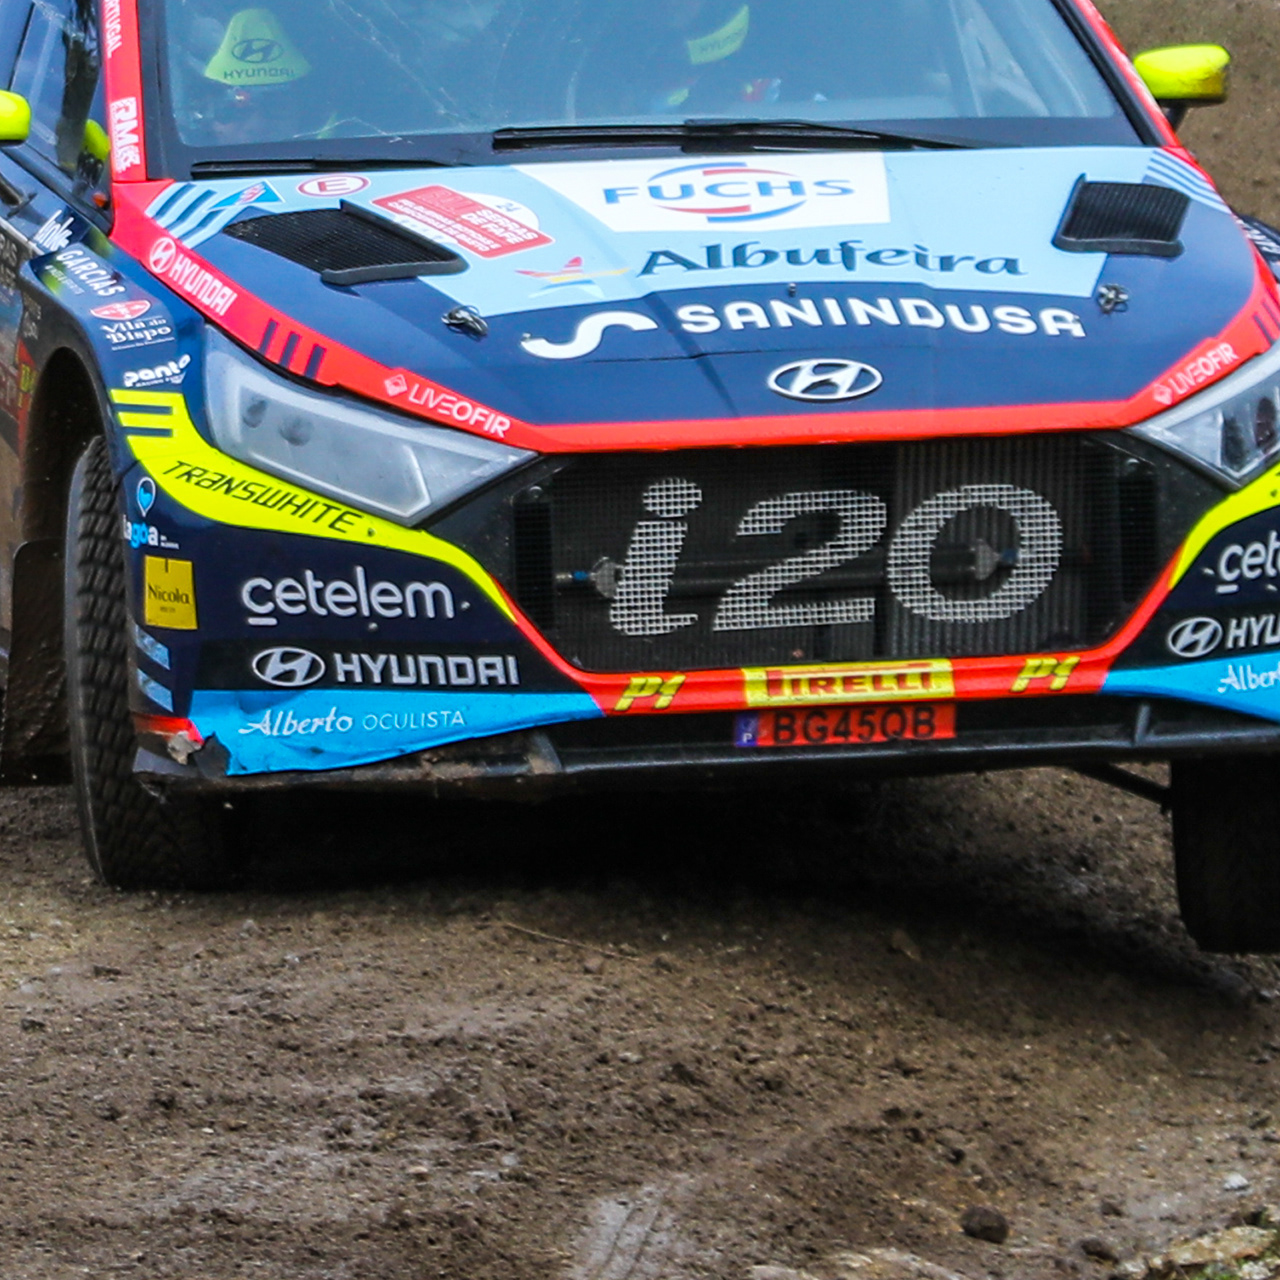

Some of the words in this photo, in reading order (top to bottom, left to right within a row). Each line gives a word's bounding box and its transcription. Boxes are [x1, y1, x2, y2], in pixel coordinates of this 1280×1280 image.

[223, 67, 295, 80] HYUNDAI
[603, 177, 856, 206] FUCHS
[461, 213, 486, 226] DE
[481, 223, 524, 245] FAFE
[476, 209, 539, 241] SERRAS
[56, 249, 126, 297] GARCIAS
[635, 239, 1029, 278] Albufeira
[168, 253, 238, 316] HYUNDAI
[101, 320, 146, 333] Vila
[106, 325, 172, 344] Bispo
[675, 297, 1087, 339] SANINDUSA
[1168, 342, 1240, 395] LIVEOFIR
[408, 383, 511, 438] LIVEOFIR
[162, 460, 365, 534] TRANSWHITE
[609, 477, 1064, 636] i20
[147, 583, 191, 605] Nicola
[241, 565, 456, 626] cetelem
[333, 652, 520, 686] HYUNDAI
[766, 661, 935, 698] PIRELLI
[238, 705, 353, 736] Alberto
[361, 709, 466, 731] OCULISTA
[771, 705, 937, 746] BG45QB
